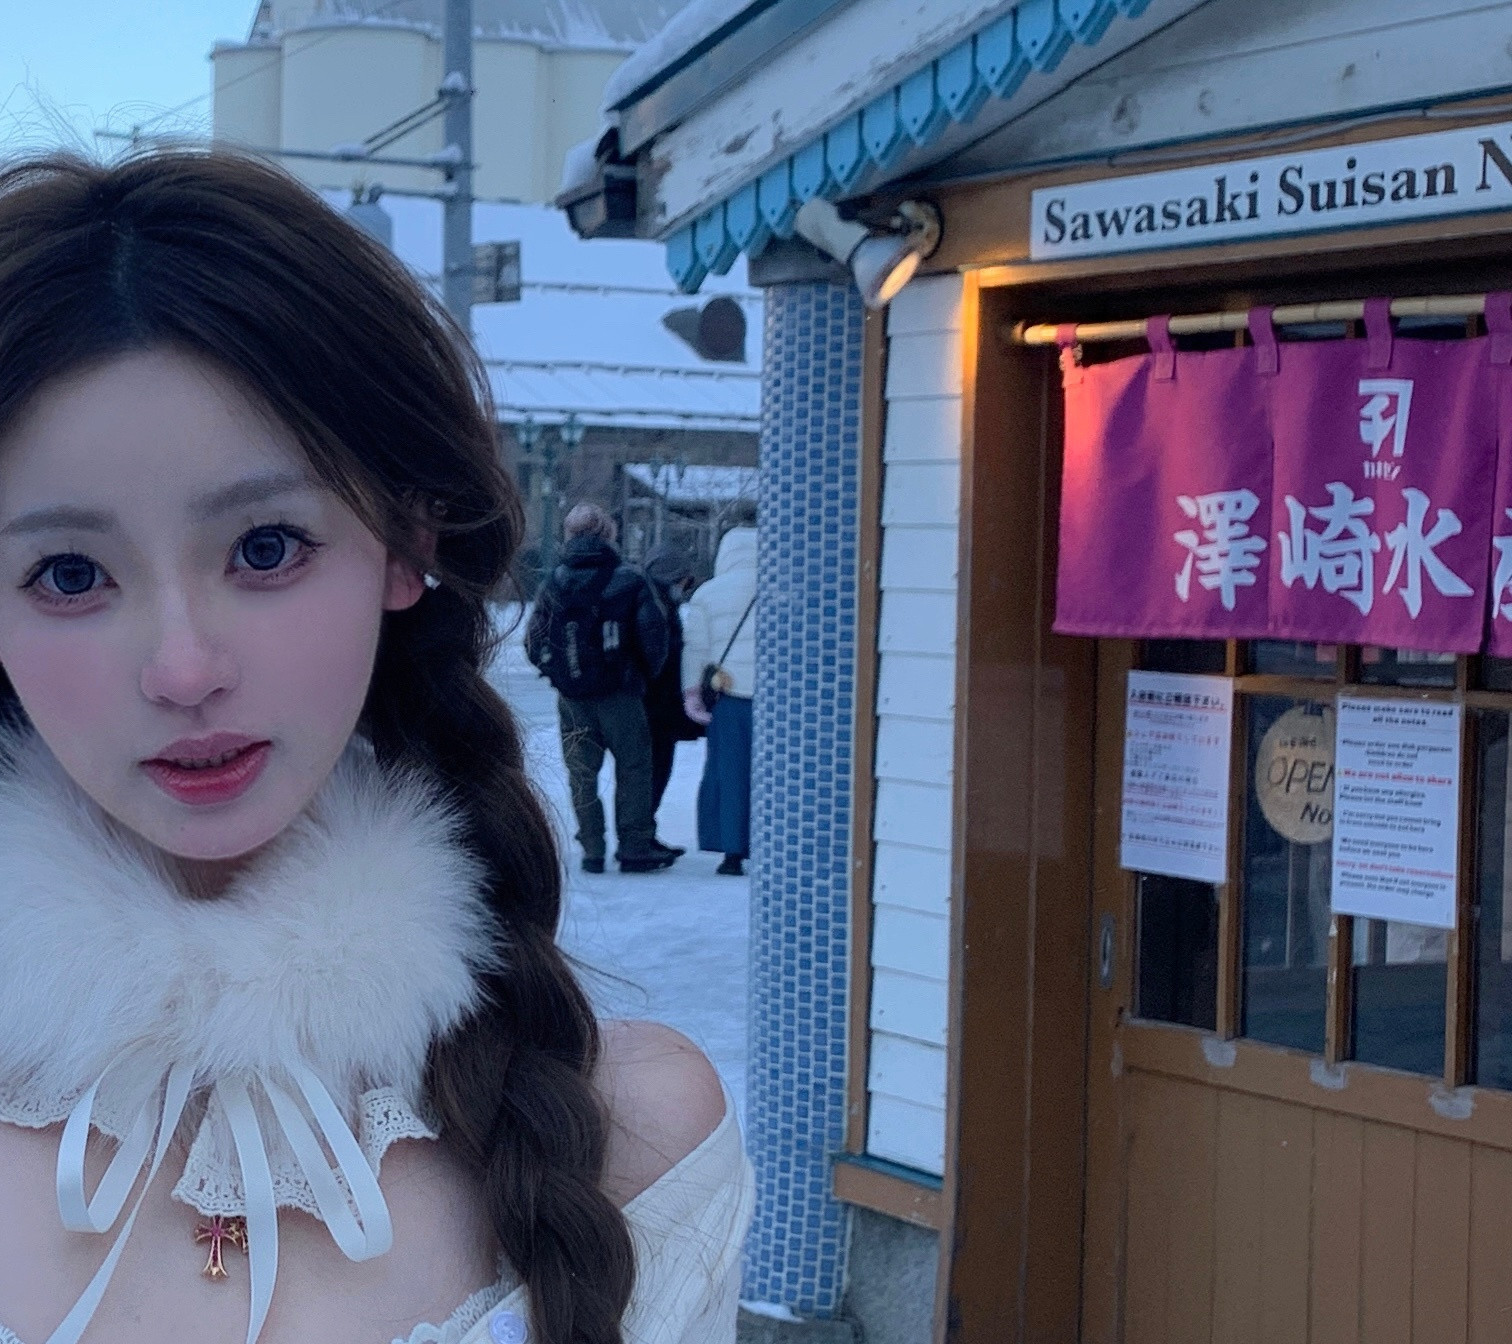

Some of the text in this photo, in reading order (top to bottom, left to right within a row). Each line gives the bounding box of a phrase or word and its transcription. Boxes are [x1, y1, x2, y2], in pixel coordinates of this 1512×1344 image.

[1043, 173, 1260, 244] Sawasaki
[1277, 156, 1458, 216] Suisan
[1342, 702, 1371, 710] Please
[1386, 716, 1399, 724] the
